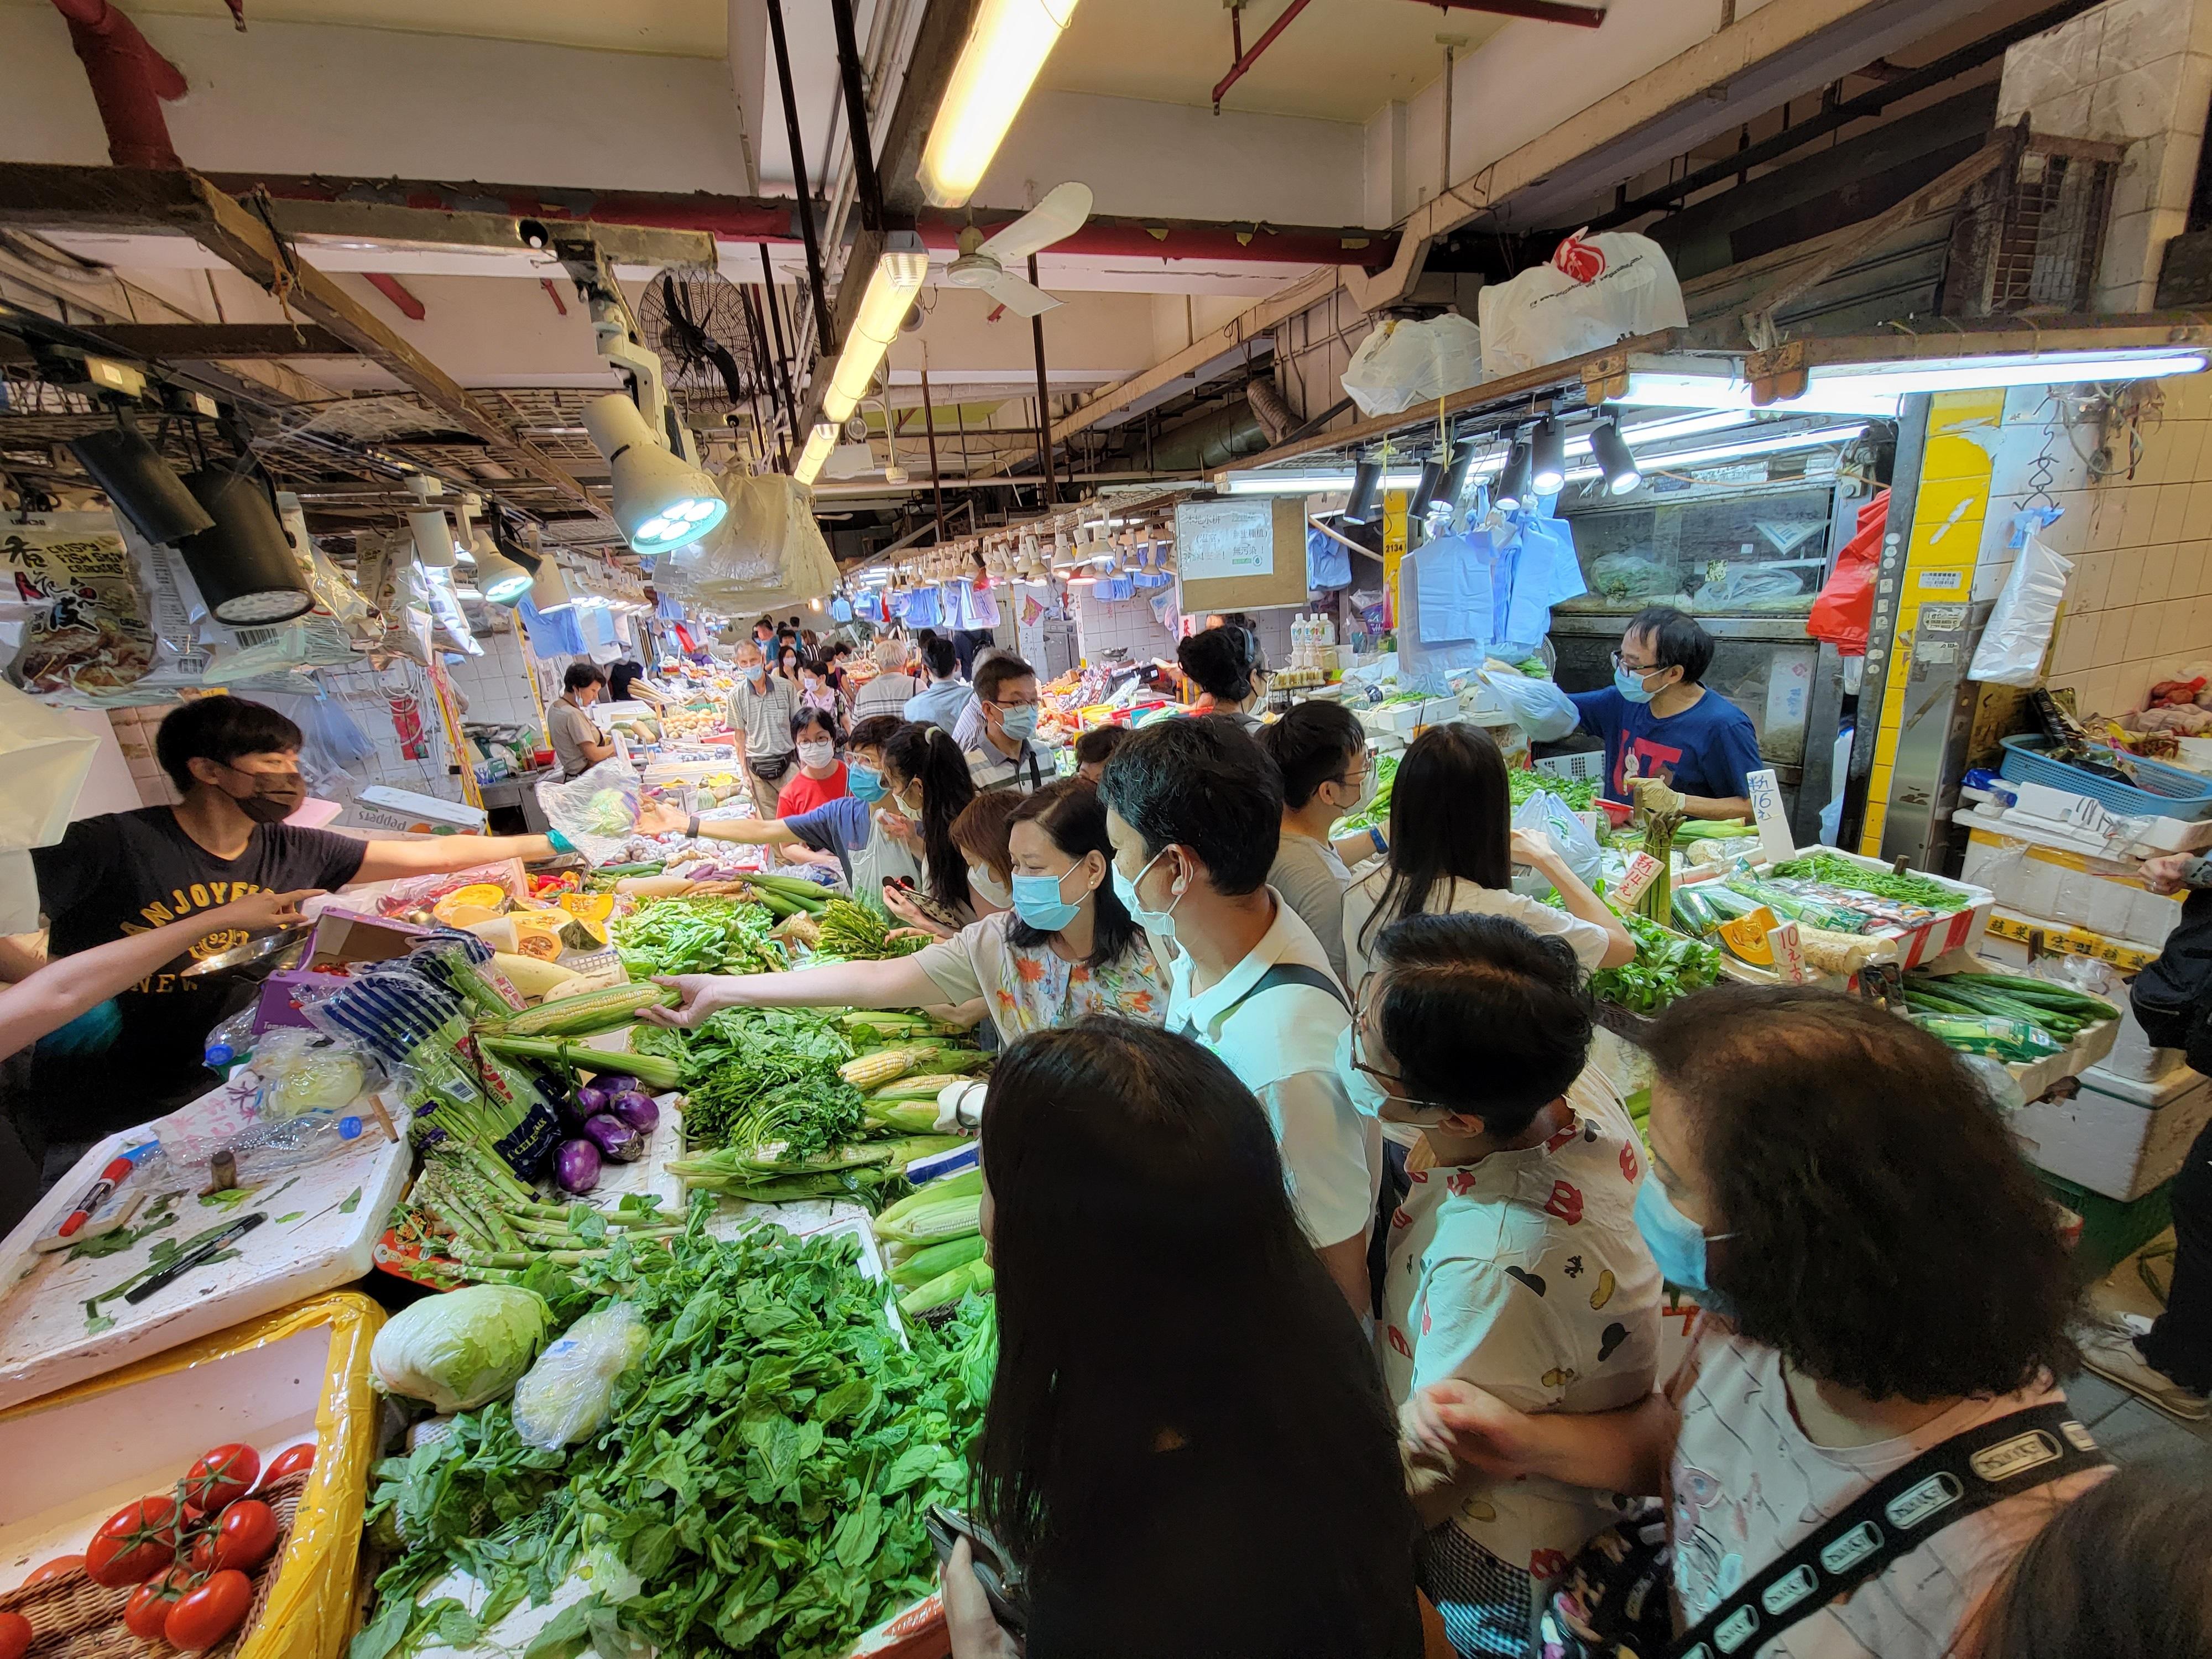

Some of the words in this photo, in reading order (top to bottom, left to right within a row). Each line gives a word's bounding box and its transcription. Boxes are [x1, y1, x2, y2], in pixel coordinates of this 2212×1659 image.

[46, 542, 100, 553] CRISPY
[56, 554, 93, 564] FISH
[1754, 792, 1771, 808] 16
[359, 811, 407, 832] peppers
[1781, 926, 1798, 949] 10
[448, 1047, 461, 1057] OF
